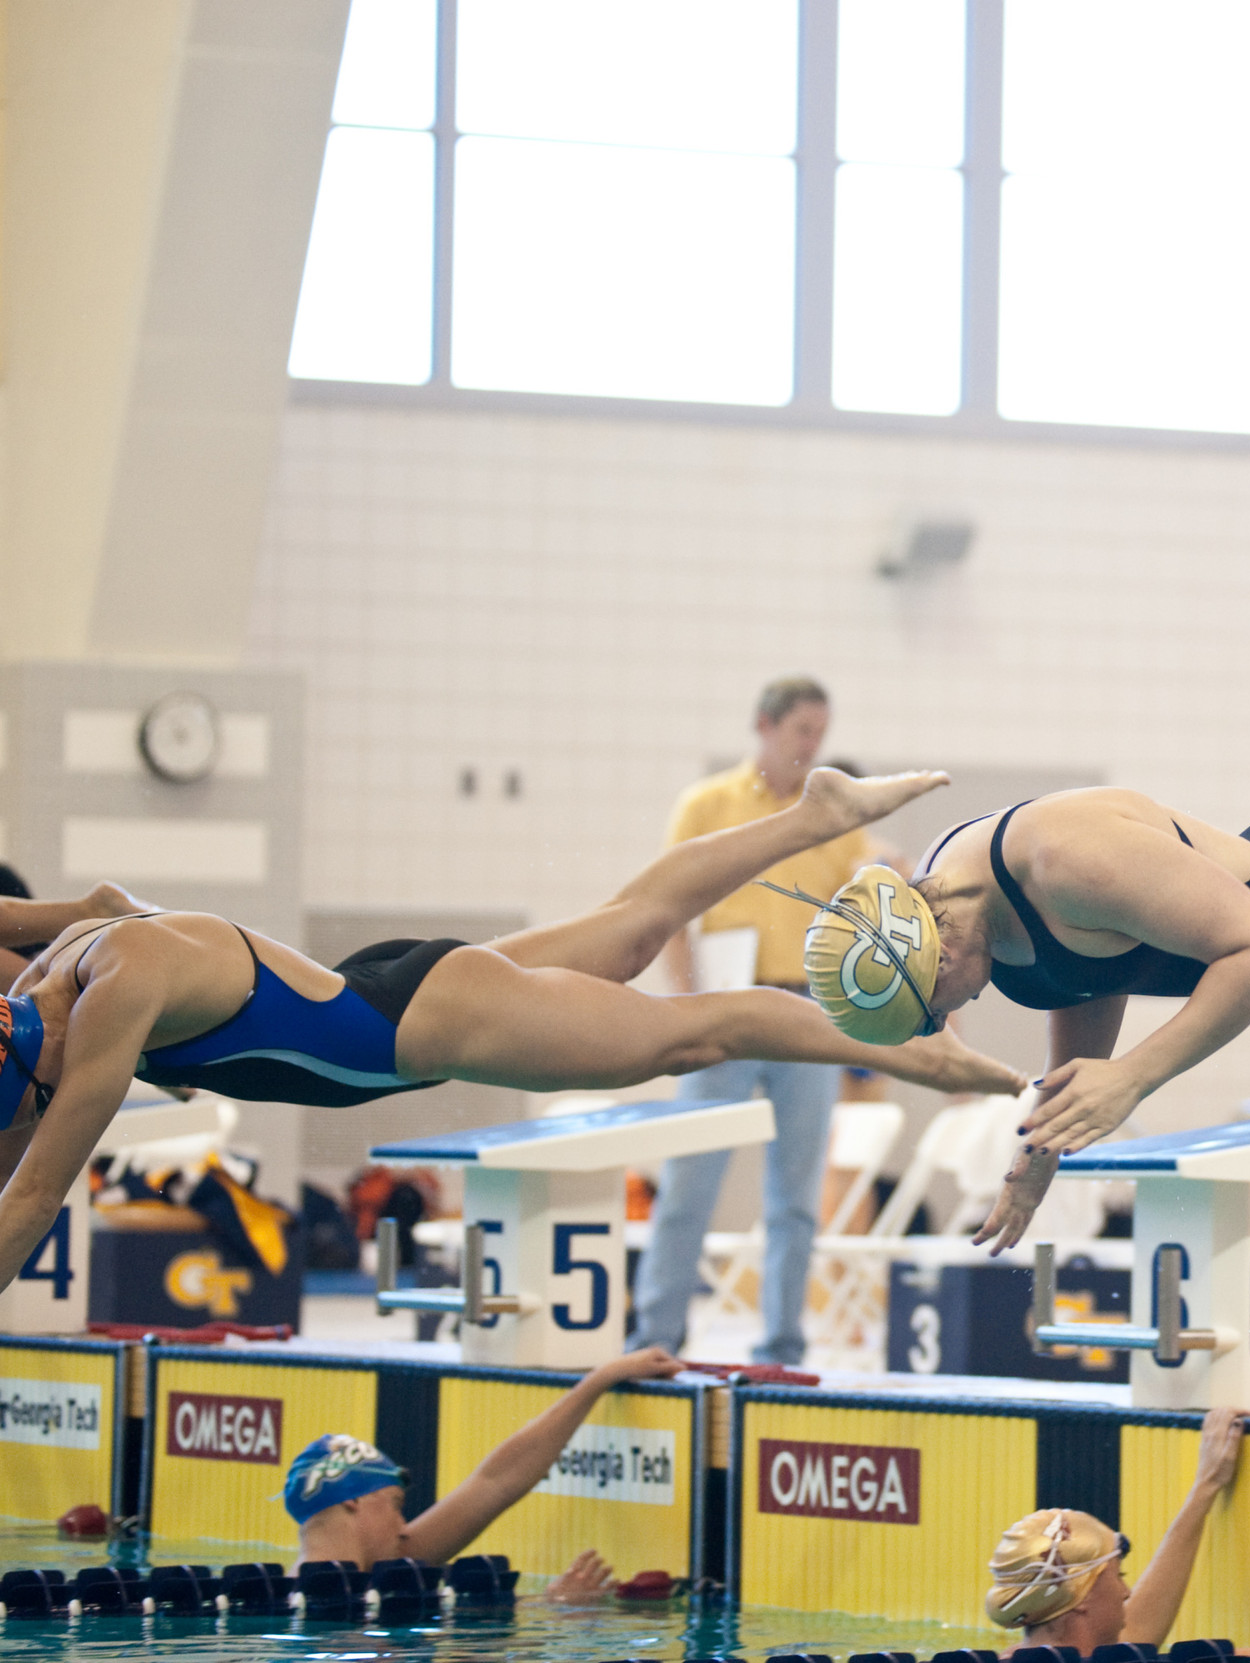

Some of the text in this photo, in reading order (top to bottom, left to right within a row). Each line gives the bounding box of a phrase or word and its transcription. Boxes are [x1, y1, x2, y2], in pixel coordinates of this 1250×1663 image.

[18, 1205, 74, 1300] 4
[552, 1223, 610, 1331] 5
[909, 1303, 942, 1375] 3
[11, 1394, 62, 1434] Georgia
[67, 1399, 98, 1431] Tech
[175, 1401, 277, 1455] OMEGA
[630, 1446, 671, 1484] Tech
[770, 1451, 908, 1514] OMEGA
